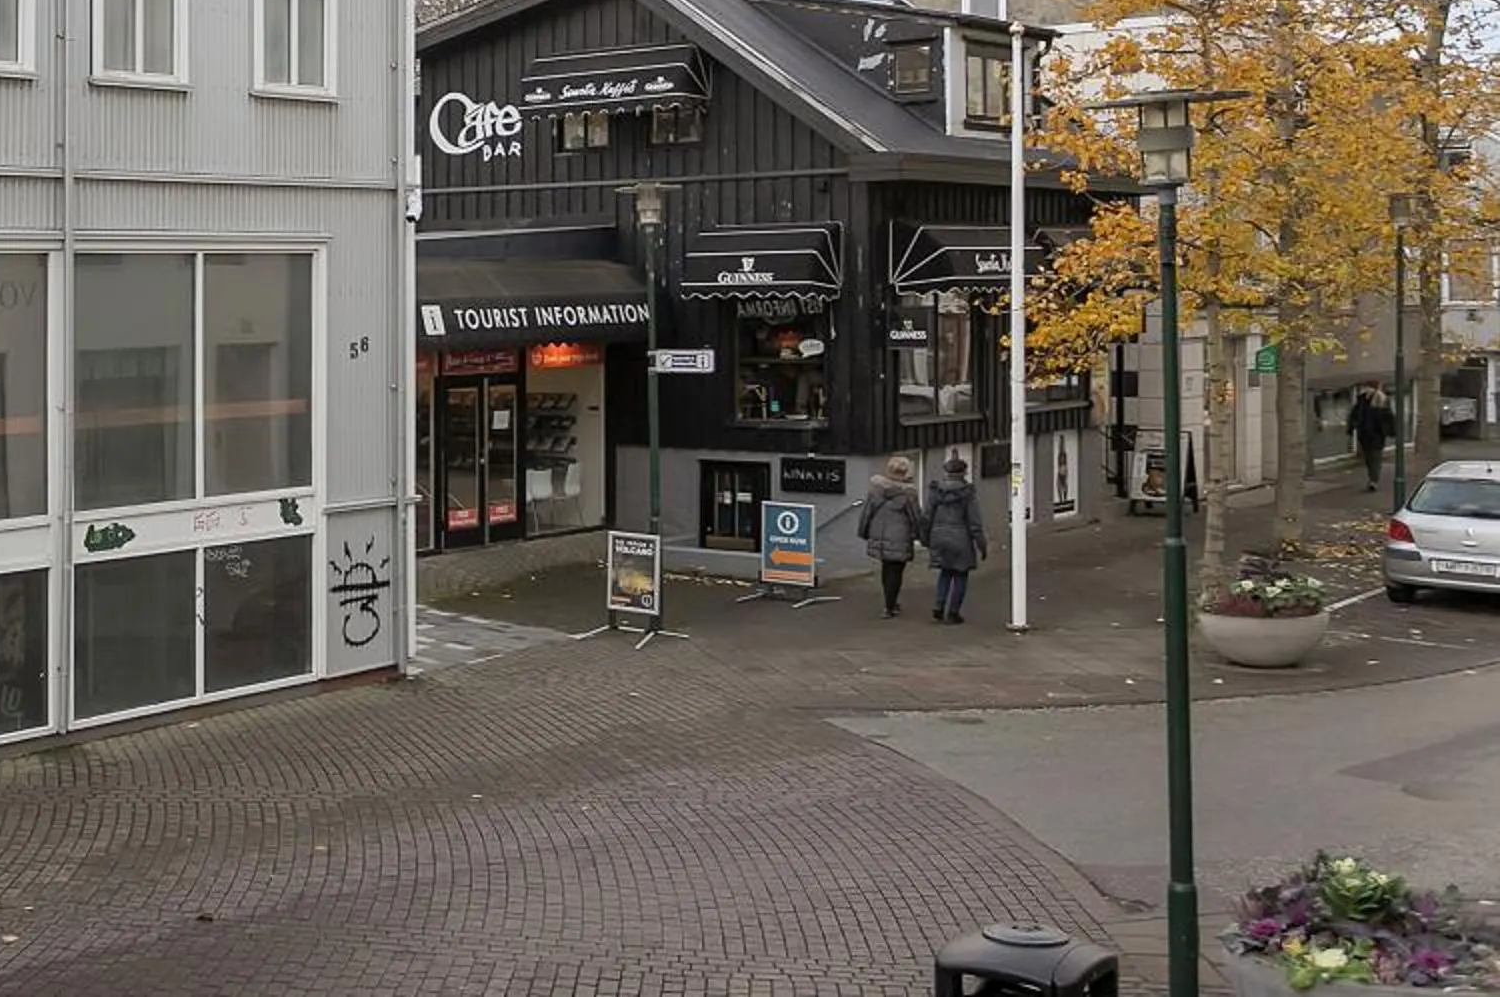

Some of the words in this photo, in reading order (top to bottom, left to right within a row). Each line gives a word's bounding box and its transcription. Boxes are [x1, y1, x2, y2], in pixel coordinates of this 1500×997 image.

[717, 271, 775, 284] GUINNESS
[454, 307, 529, 330] TOURIST
[535, 303, 650, 327] INFORMATION
[350, 336, 369, 360] 56
